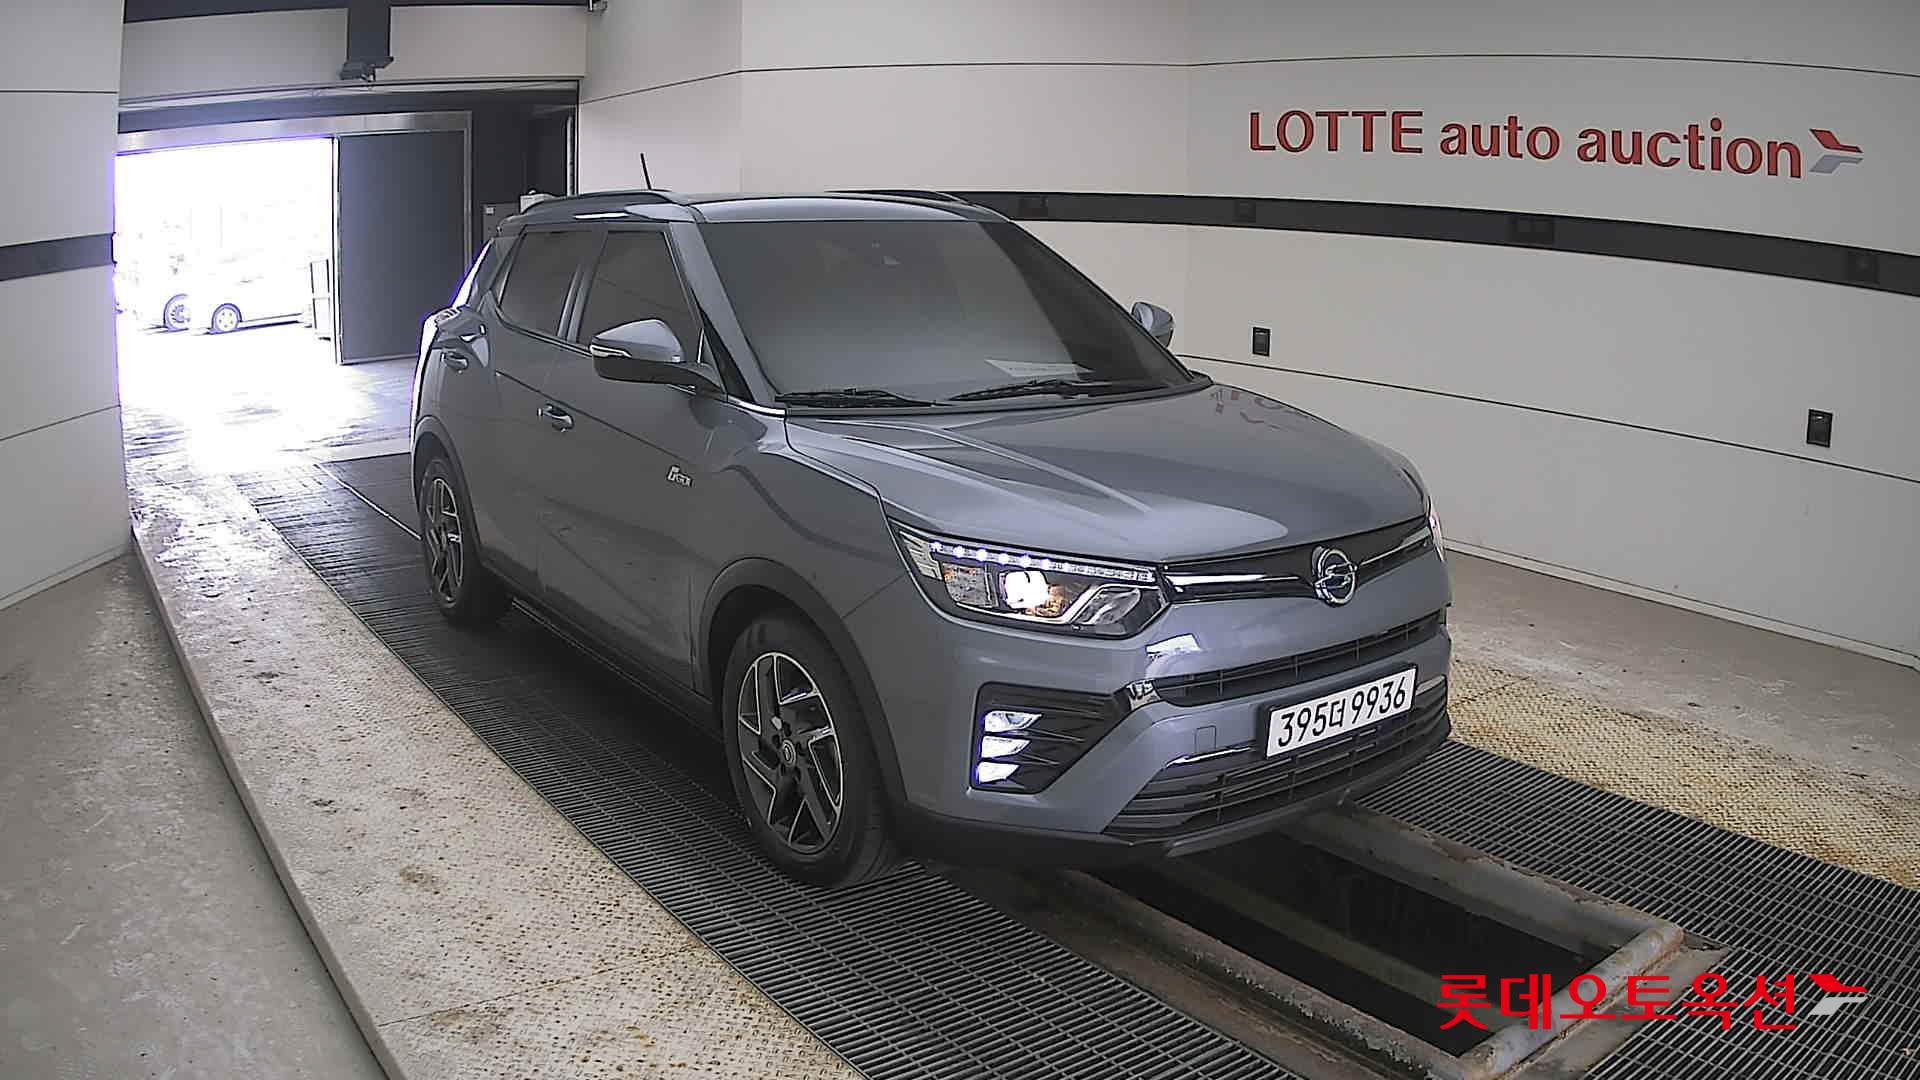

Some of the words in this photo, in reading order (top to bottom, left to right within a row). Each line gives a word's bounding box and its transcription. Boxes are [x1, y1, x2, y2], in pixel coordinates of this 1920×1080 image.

[1249, 110, 1424, 154] LOTTE
[1439, 115, 1561, 160] auto
[1577, 117, 1802, 178] auction
[1352, 676, 1406, 724] 9936
